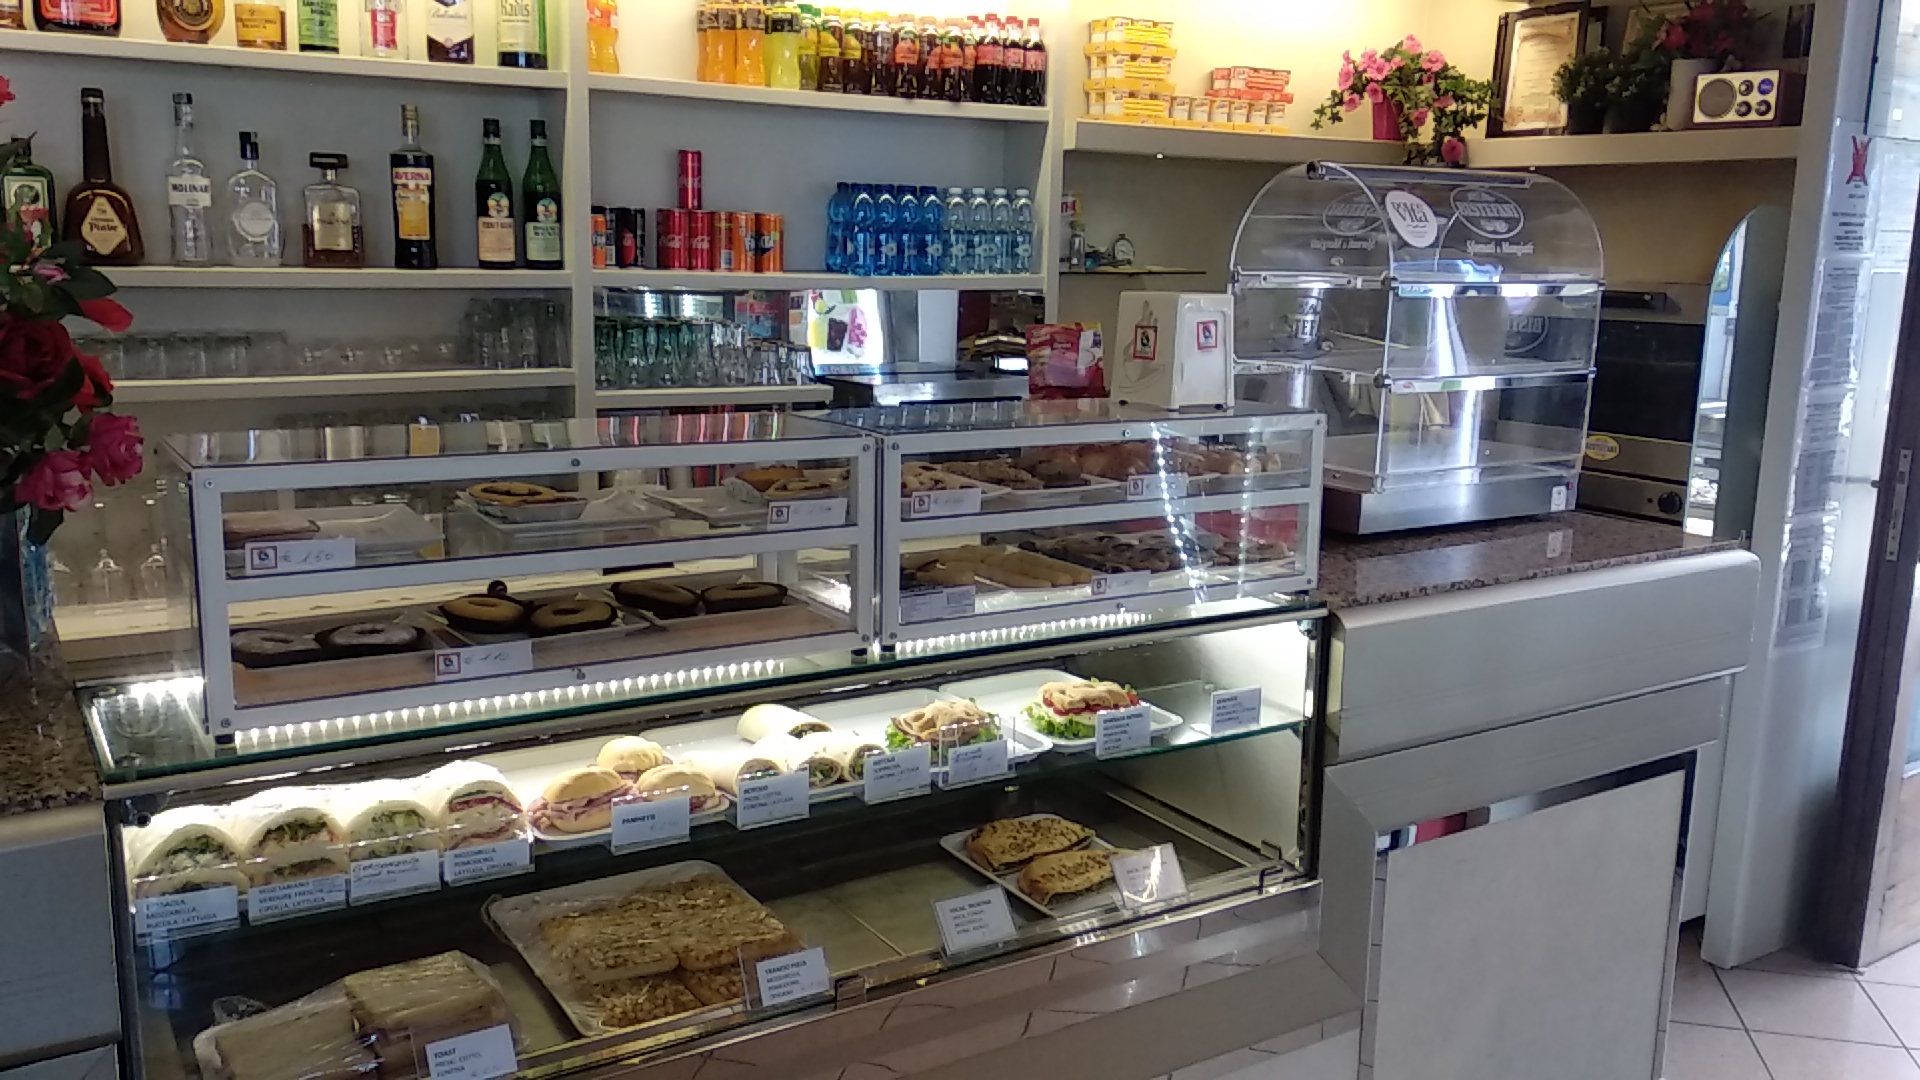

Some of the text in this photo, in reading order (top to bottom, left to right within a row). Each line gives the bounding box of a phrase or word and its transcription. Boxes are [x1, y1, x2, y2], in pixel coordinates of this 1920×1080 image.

[394, 171, 430, 181] AVERNA
[1457, 201, 1520, 217] BISTEFANI
[88, 221, 117, 233] Piave
[433, 1047, 456, 1060] TOAST
